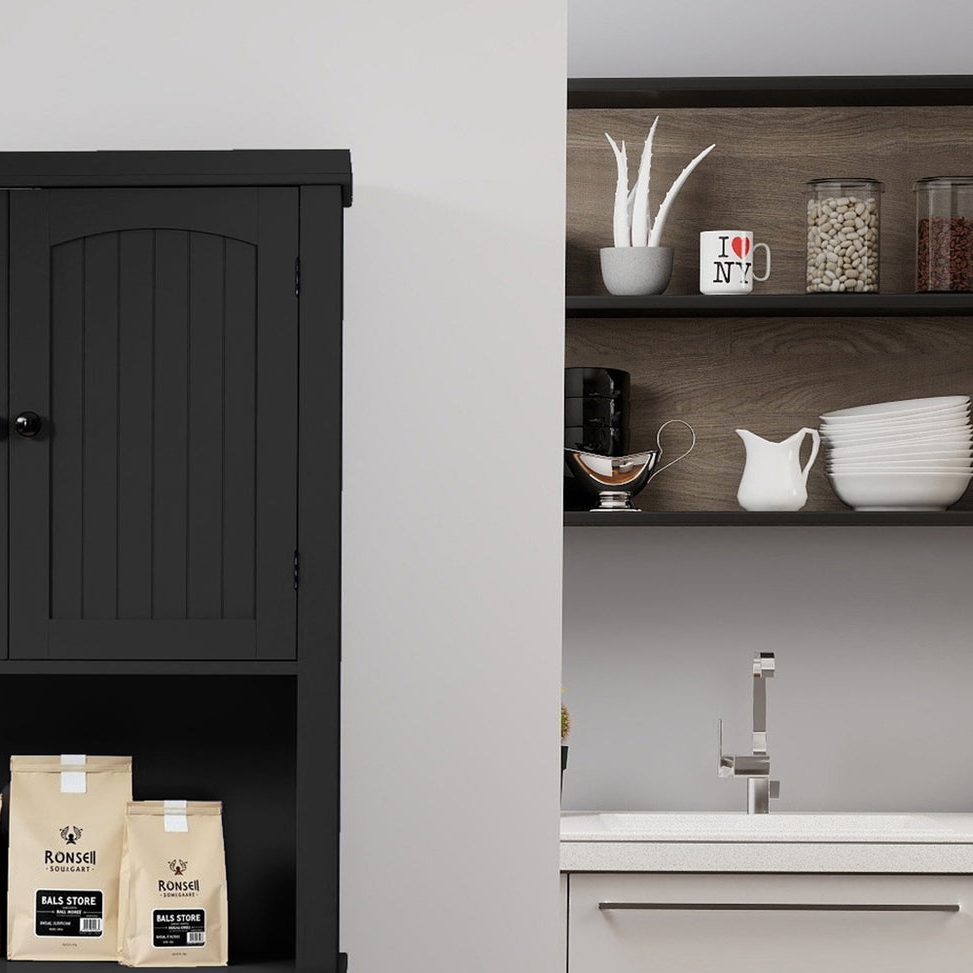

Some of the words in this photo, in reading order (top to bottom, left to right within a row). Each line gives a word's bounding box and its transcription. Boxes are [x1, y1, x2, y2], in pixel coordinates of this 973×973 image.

[718, 235, 729, 258] I
[712, 261, 751, 284] NY
[41, 895, 64, 905] BALS
[66, 896, 97, 906] STORE
[156, 914, 175, 922] BALS
[176, 913, 201, 922] STORE
